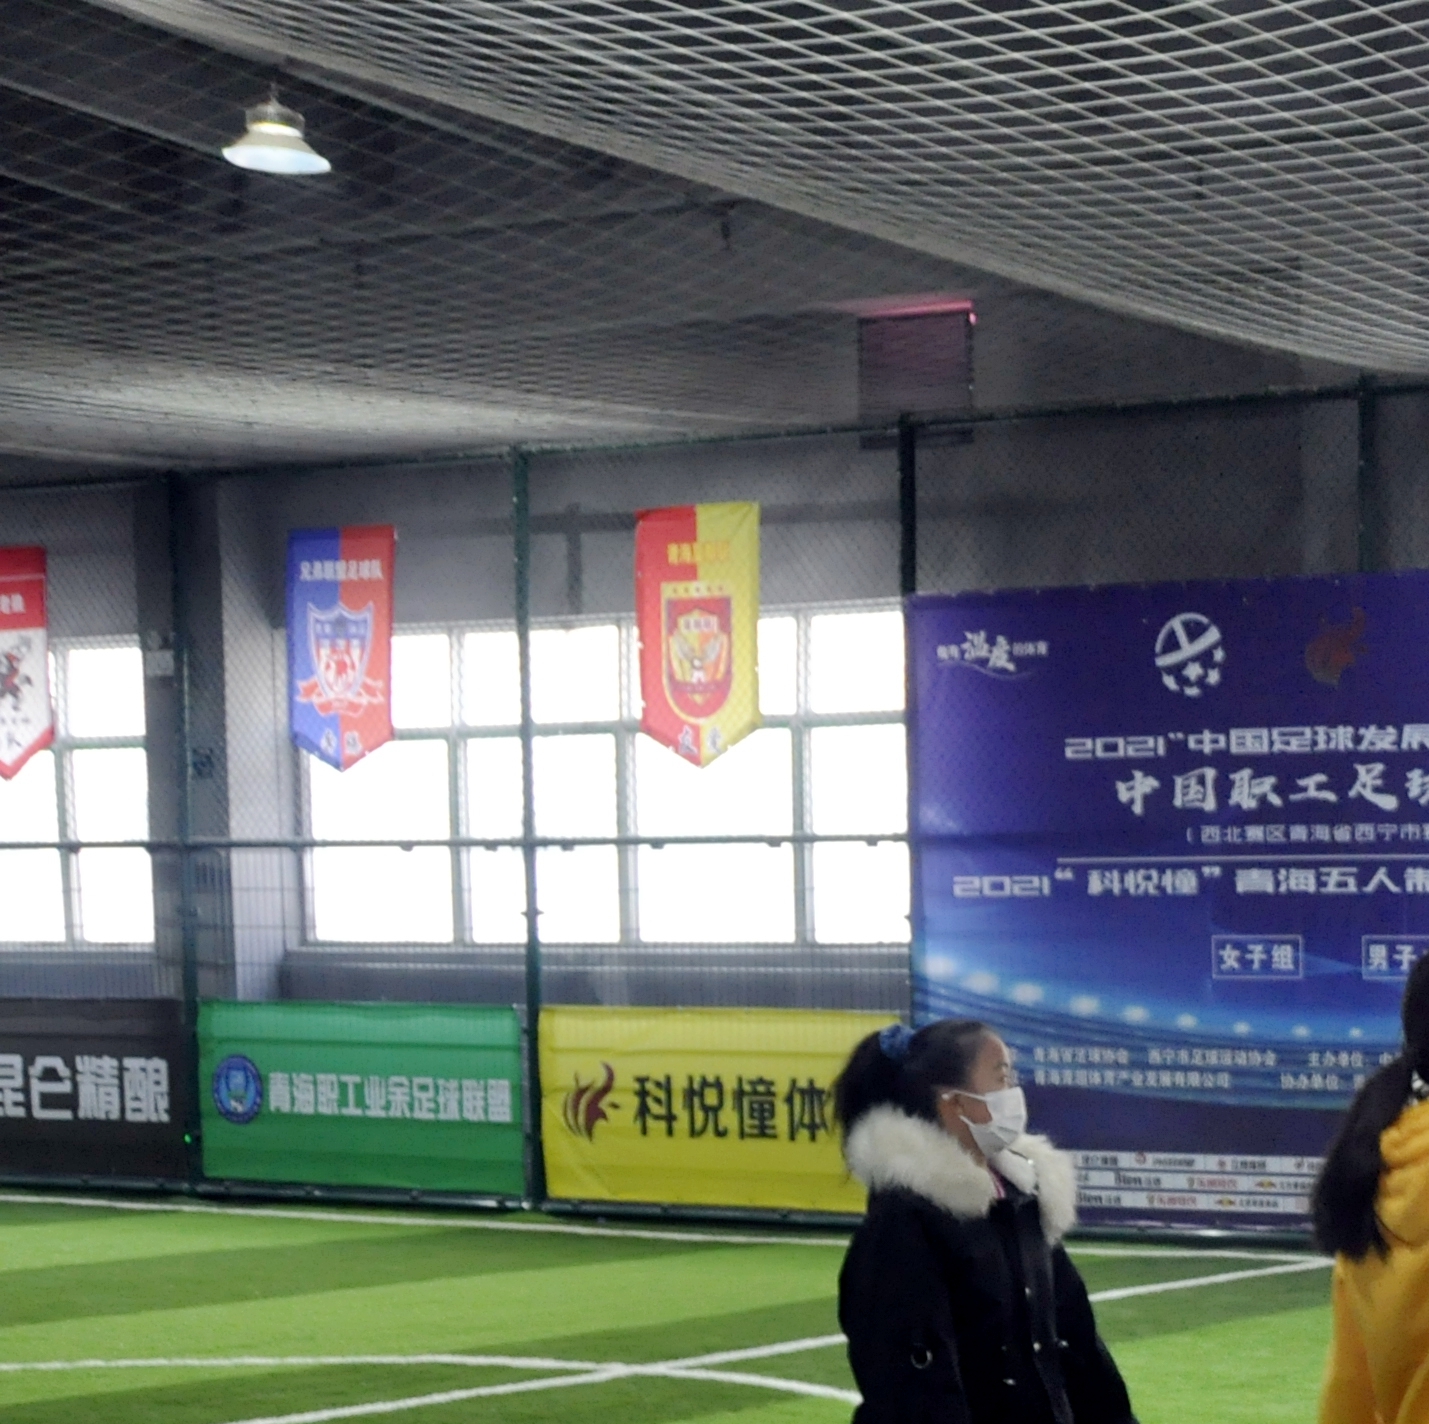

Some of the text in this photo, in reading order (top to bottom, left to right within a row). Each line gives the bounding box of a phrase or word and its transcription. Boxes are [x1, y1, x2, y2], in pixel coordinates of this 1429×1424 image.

[1218, 943, 1296, 971] 女子组
[268, 1072, 513, 1124] 青海职工业余足球联盟
